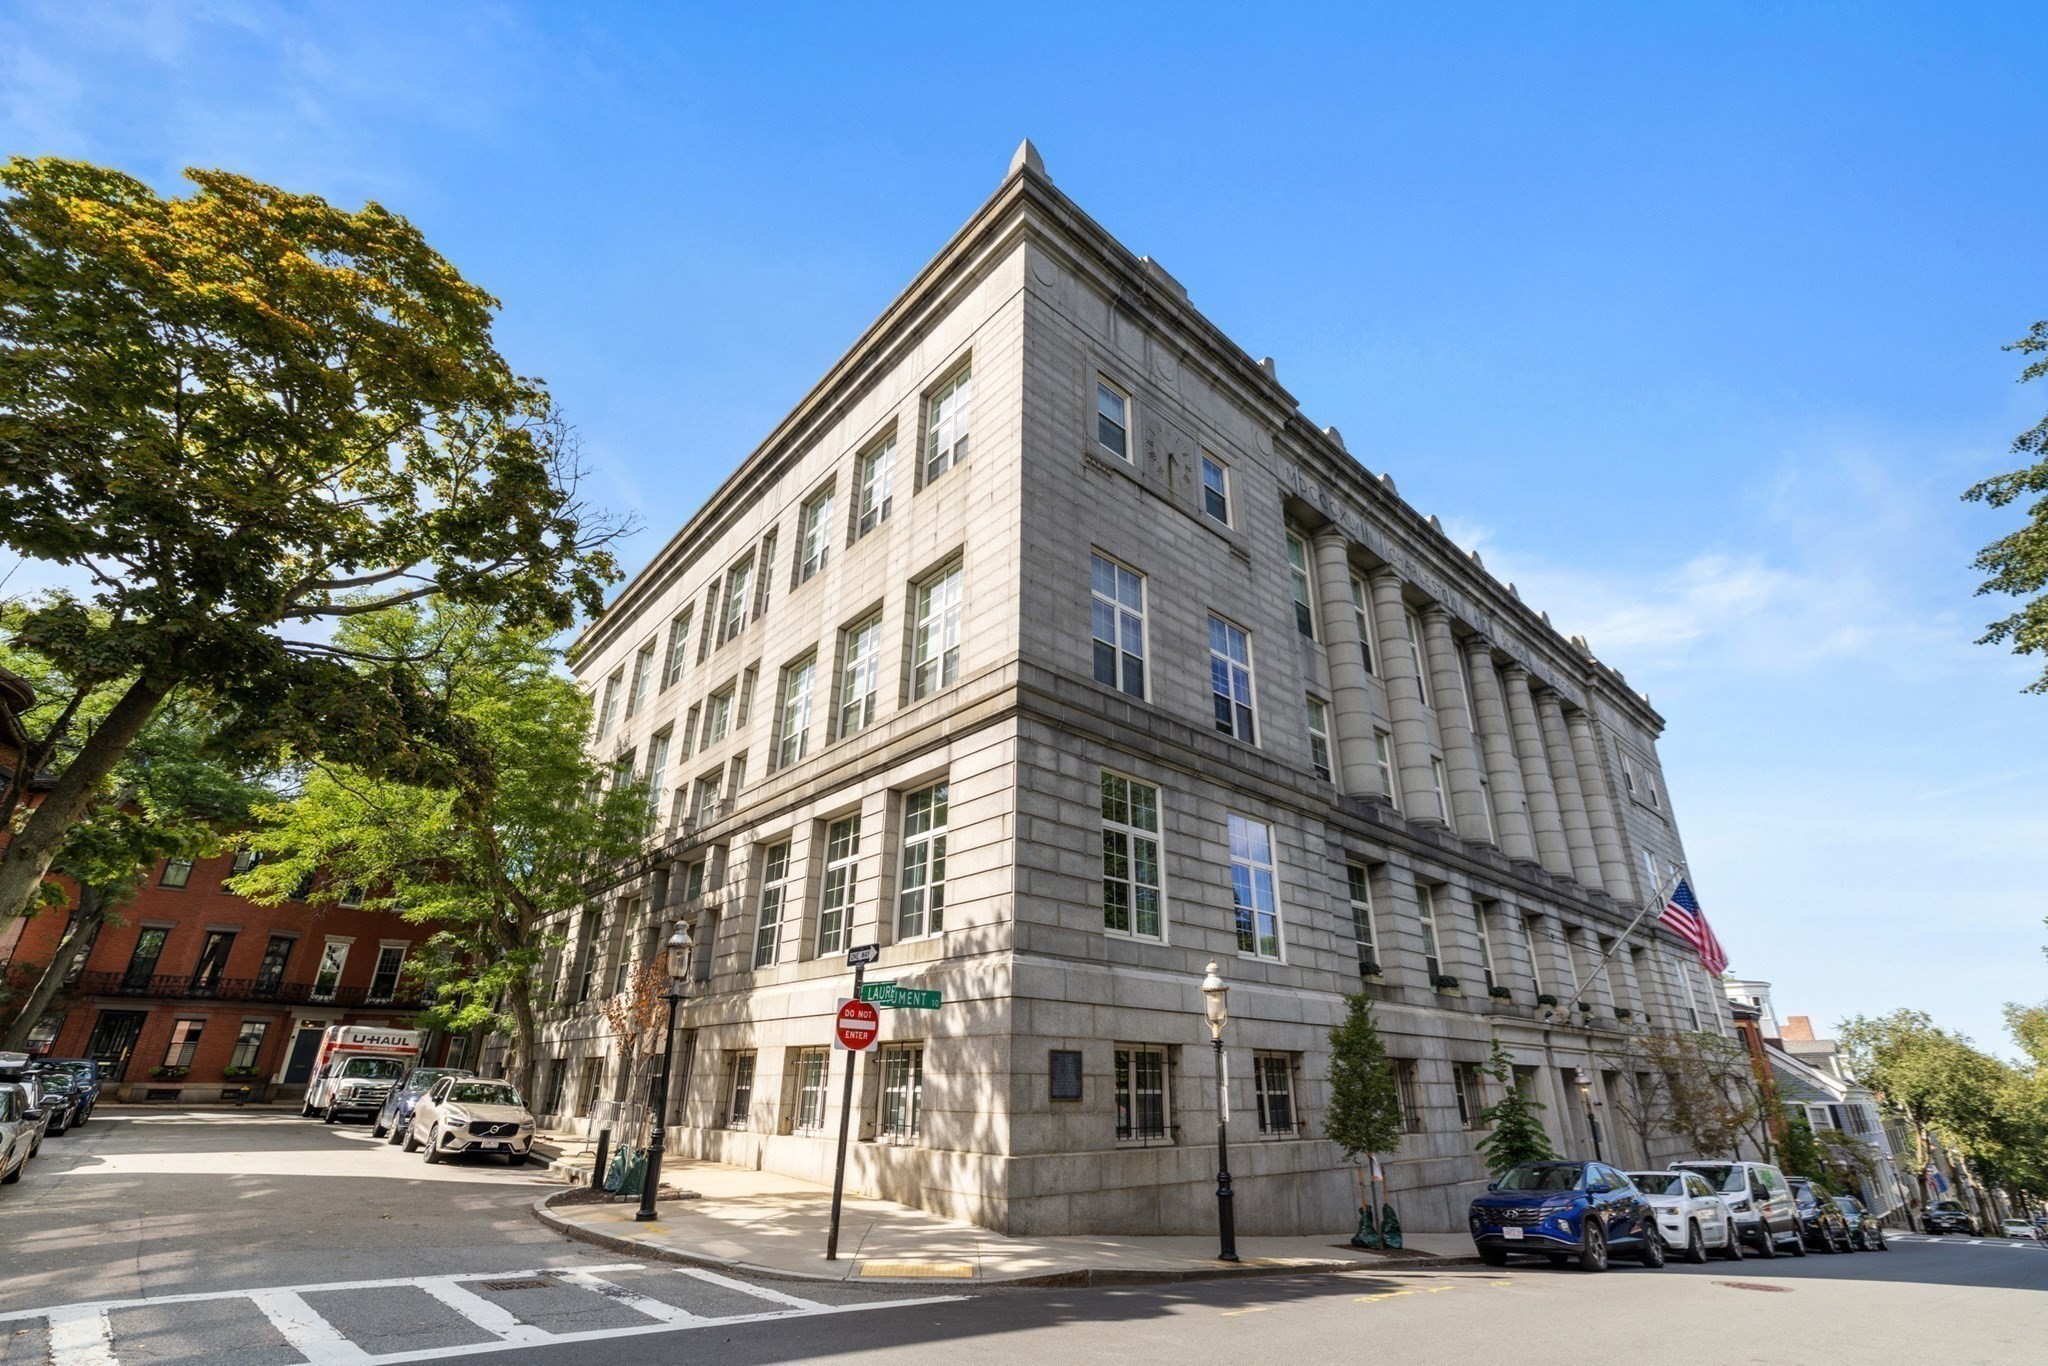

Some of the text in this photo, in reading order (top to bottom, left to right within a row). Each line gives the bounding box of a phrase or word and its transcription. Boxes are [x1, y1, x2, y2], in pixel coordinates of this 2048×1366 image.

[850, 950, 870, 961] ONE WAY
[889, 990, 939, 1007] UMENT SQ
[844, 1009, 872, 1018] DO NOT
[353, 1034, 409, 1046] U-HAUL
[845, 1031, 868, 1039] ENTER
